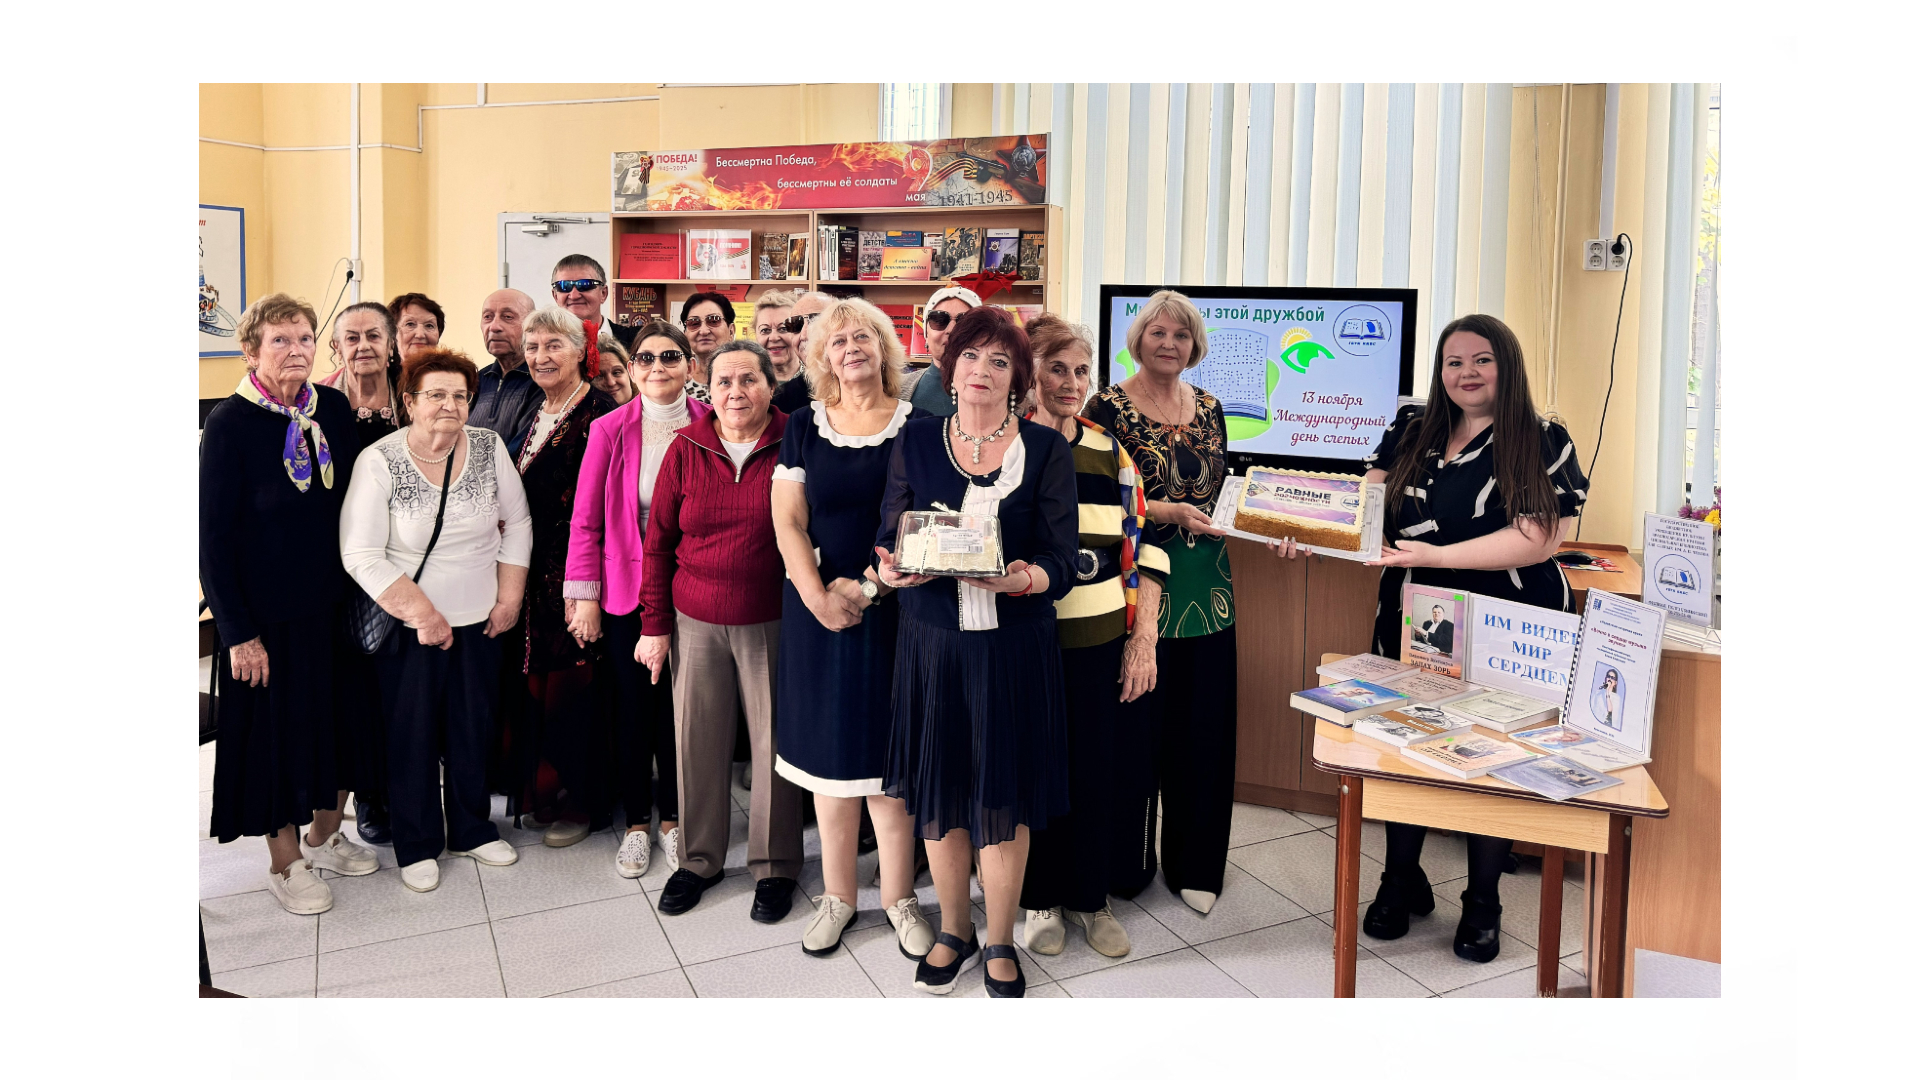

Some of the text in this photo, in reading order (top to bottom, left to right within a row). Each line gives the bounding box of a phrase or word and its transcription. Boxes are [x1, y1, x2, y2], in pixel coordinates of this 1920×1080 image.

[656, 154, 698, 164] ПОБЕДА!
[716, 154, 817, 169] Бессмертна Победа,
[777, 176, 898, 190] бессмертны её солдаты
[905, 192, 926, 201] мая
[939, 189, 1013, 207] 1941-1945
[622, 287, 657, 300] КУБАНЬ
[1214, 304, 1249, 320] этой
[1252, 306, 1325, 324] дружбой
[1302, 391, 1363, 411] 13 ноября
[1273, 408, 1386, 431] Международный
[1290, 432, 1370, 446] день слепых
[1275, 486, 1332, 500] РАВНЫЕ
[1484, 613, 1511, 631] ИМ
[1511, 640, 1552, 660] МИР
[1410, 659, 1432, 670] ЗАПАХ
[1433, 664, 1451, 675] ЗОРЬ
